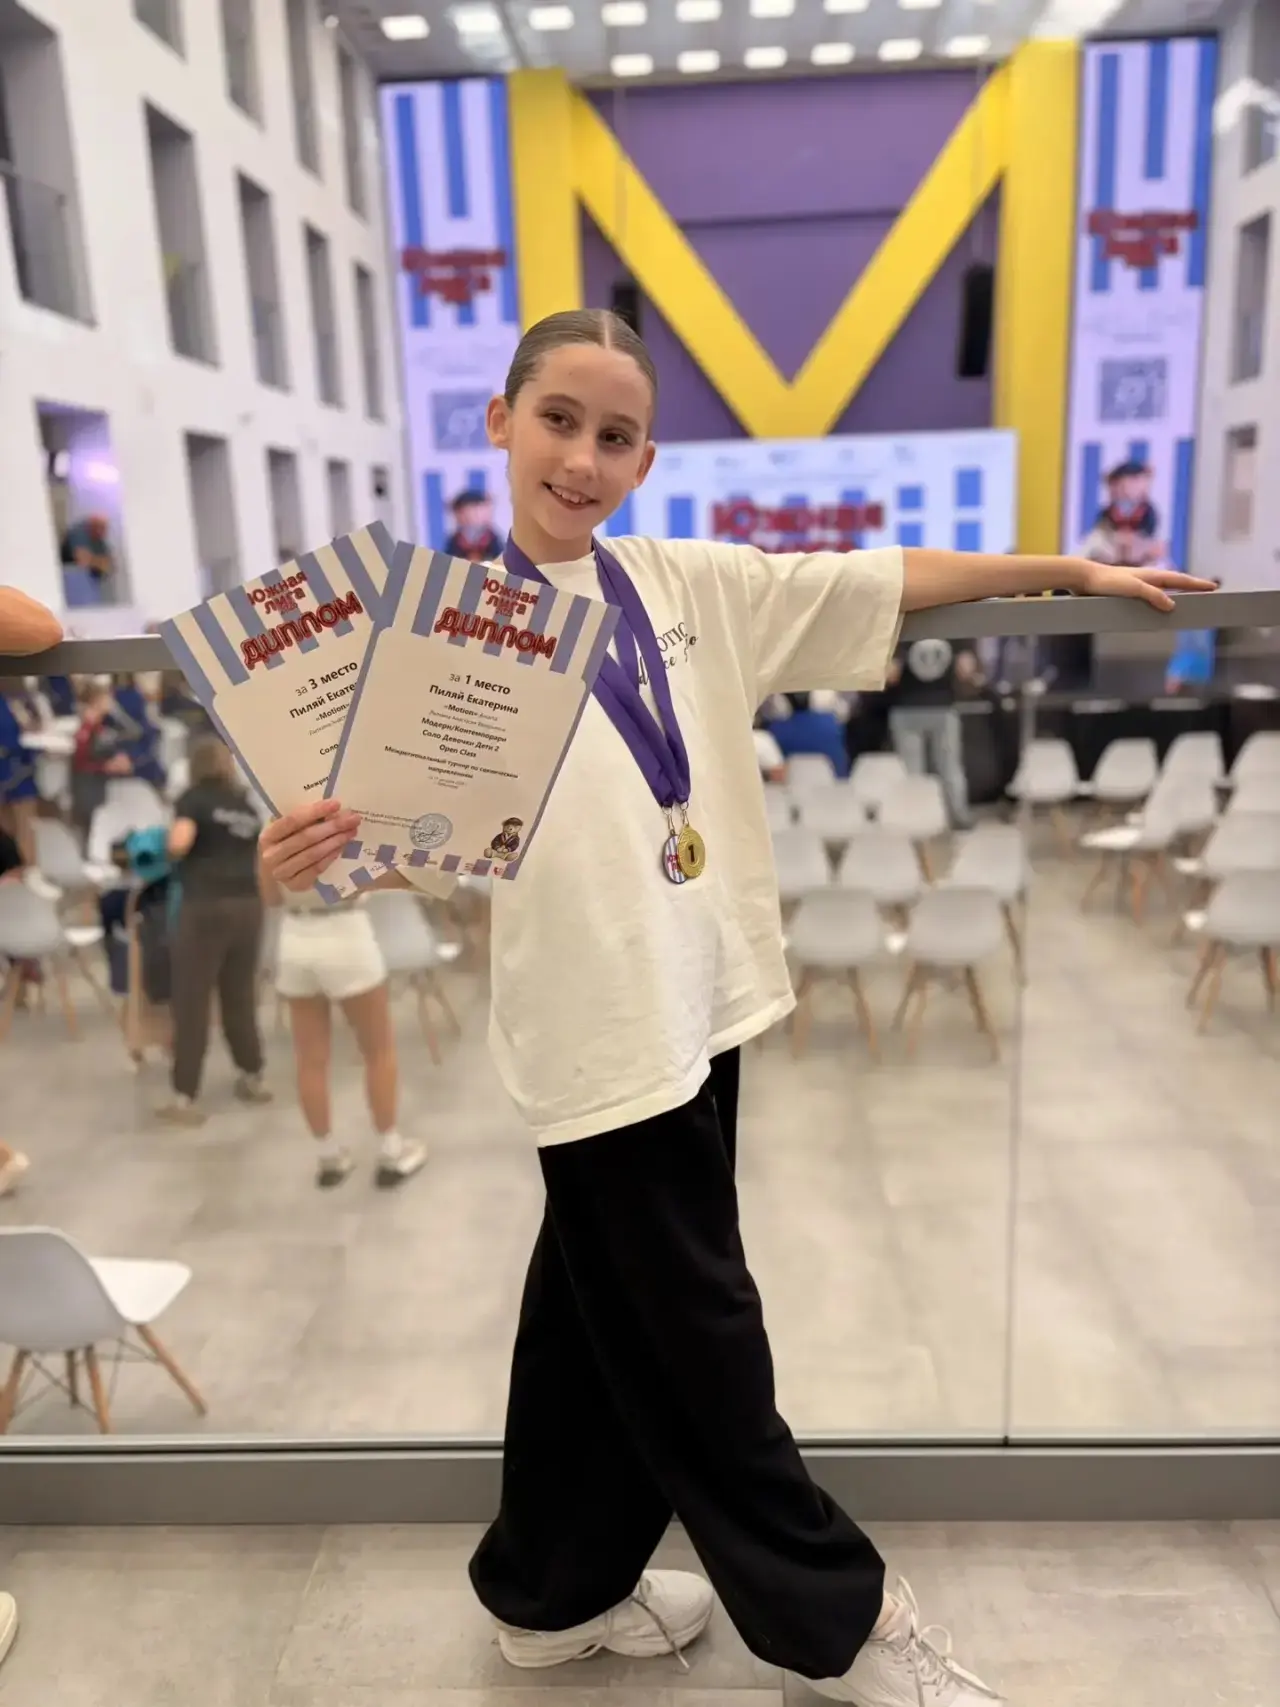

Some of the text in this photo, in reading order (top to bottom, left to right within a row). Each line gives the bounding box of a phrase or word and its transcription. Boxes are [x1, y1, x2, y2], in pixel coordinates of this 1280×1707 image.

[247, 570, 308, 606] Южная
[482, 577, 540, 605] Южная
[295, 661, 358, 697] за 3 место
[448, 673, 511, 695] за 1 место
[289, 682, 358, 719] Пиляй Екате
[429, 684, 519, 715] Пиляй Екатерина
[319, 743, 339, 756] Соло
[422, 729, 441, 740] Соло
[442, 734, 474, 747] Девочки
[475, 741, 493, 751] Дети
[439, 744, 477, 758] Open Class
[688, 844, 695, 862] 1
